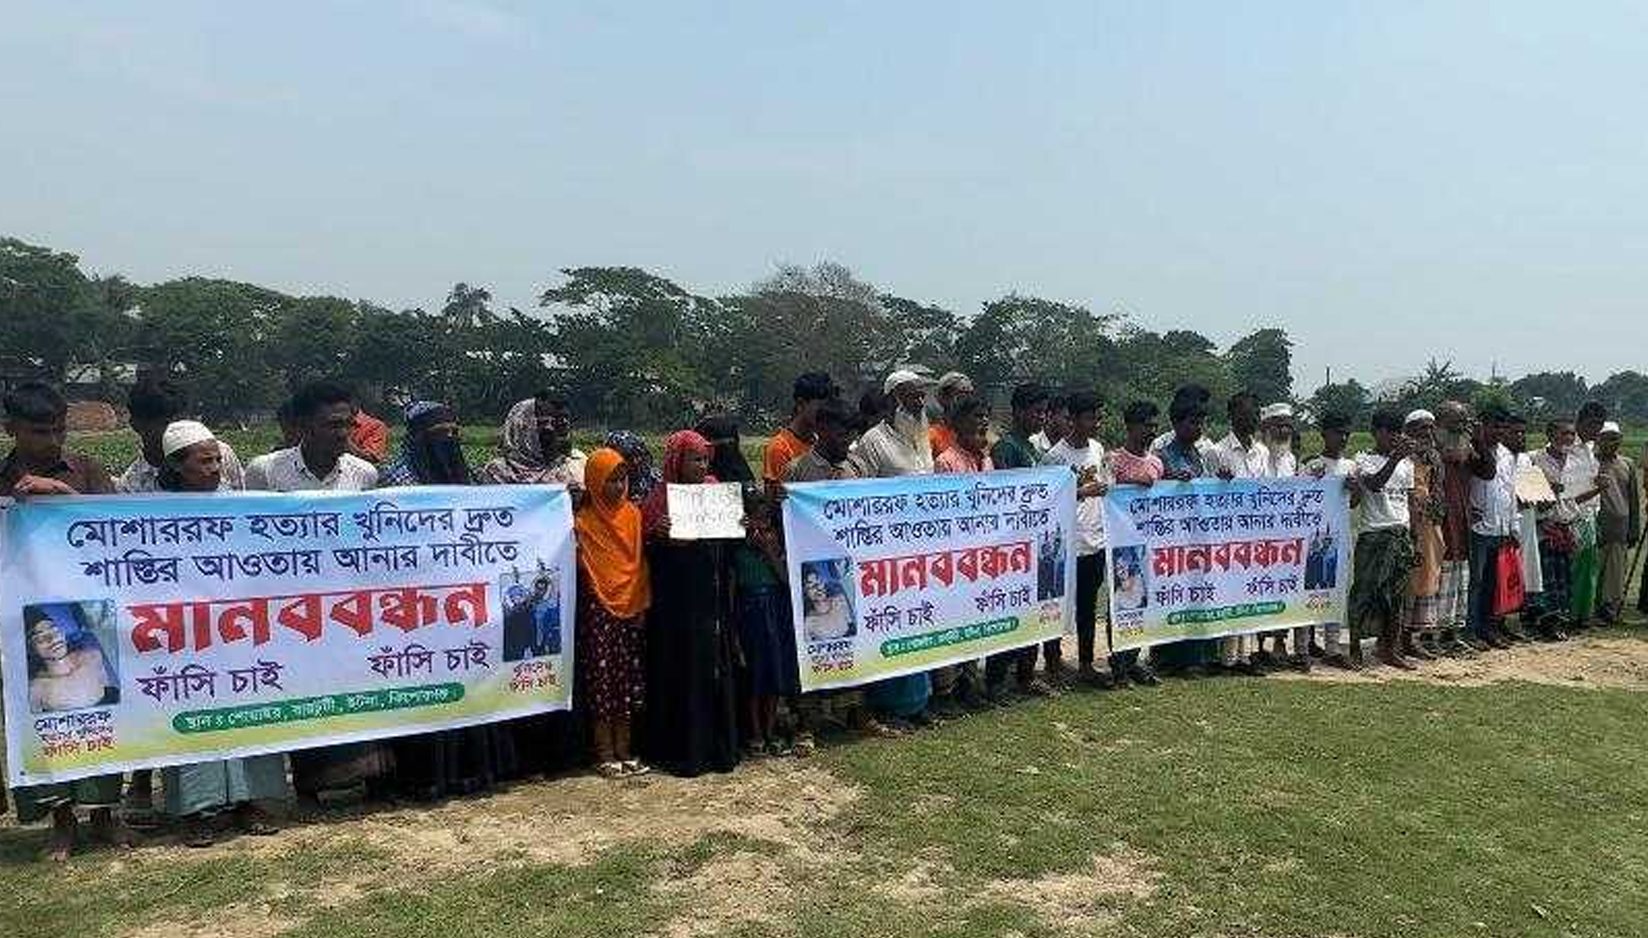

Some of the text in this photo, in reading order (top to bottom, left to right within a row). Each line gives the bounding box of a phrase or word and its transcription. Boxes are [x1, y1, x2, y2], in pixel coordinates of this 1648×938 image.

[823, 496, 908, 520] মোশাররফ
[916, 492, 960, 512] হত্যার
[965, 482, 1016, 510] খুনিদের
[67, 501, 517, 549] মোশাররফ হত্যার খুনিদের দ্রুত
[834, 521, 884, 548] শাস্তির
[889, 518, 953, 543] আওতায়
[956, 515, 999, 535] আনার
[81, 533, 520, 587] শাস্তির আওতায় আনার দাবীতে
[859, 541, 1033, 598] মানববন্ধন
[1151, 537, 1305, 578] মানববন্ধন
[127, 582, 490, 656] মানববন্ধন
[864, 599, 937, 633] ফাঁসি চাই
[975, 586, 1031, 614] ফাঁসি চাই
[369, 639, 491, 678] ফাঁসি চাই
[136, 659, 284, 704] ফাঁসি চাই
